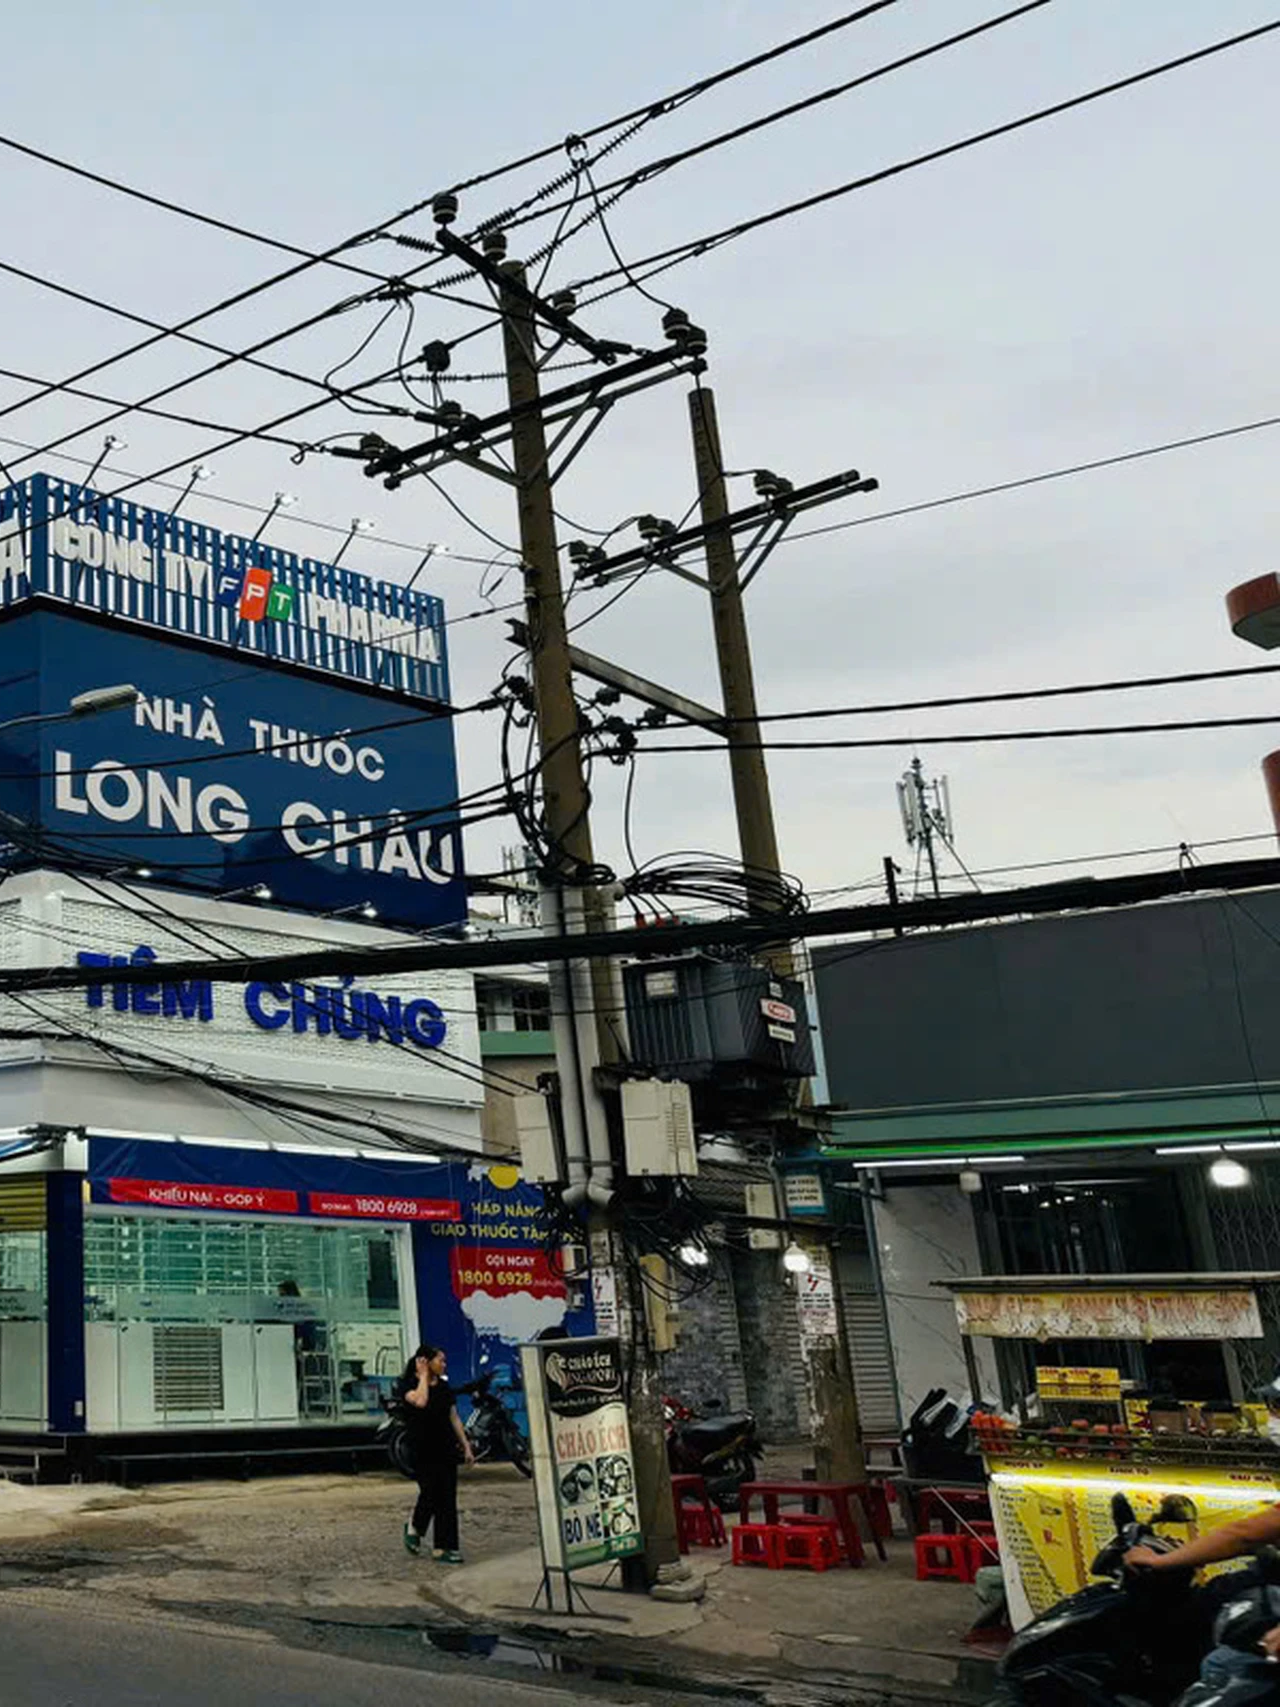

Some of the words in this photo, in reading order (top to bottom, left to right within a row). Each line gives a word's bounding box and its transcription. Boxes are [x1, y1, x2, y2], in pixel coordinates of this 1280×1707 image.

[162, 548, 211, 599] TY
[218, 568, 296, 620] FPT
[308, 590, 441, 663] PHARMA
[135, 690, 225, 746] NHÀ
[248, 717, 386, 782] THUỐC
[54, 750, 251, 844] LONG
[280, 800, 454, 885] CHÂU
[77, 945, 214, 1023] TIÊM
[244, 973, 447, 1048] CHỦNG
[355, 1199, 385, 1213] 1800
[386, 1201, 418, 1215] 6928
[431, 1222, 467, 1237] GIAO
[469, 1220, 519, 1239] THUỐC
[457, 1269, 493, 1285] 1800
[496, 1271, 533, 1286] 6928
[556, 1424, 597, 1457] CHÁO
[563, 1510, 583, 1544] BÒ
